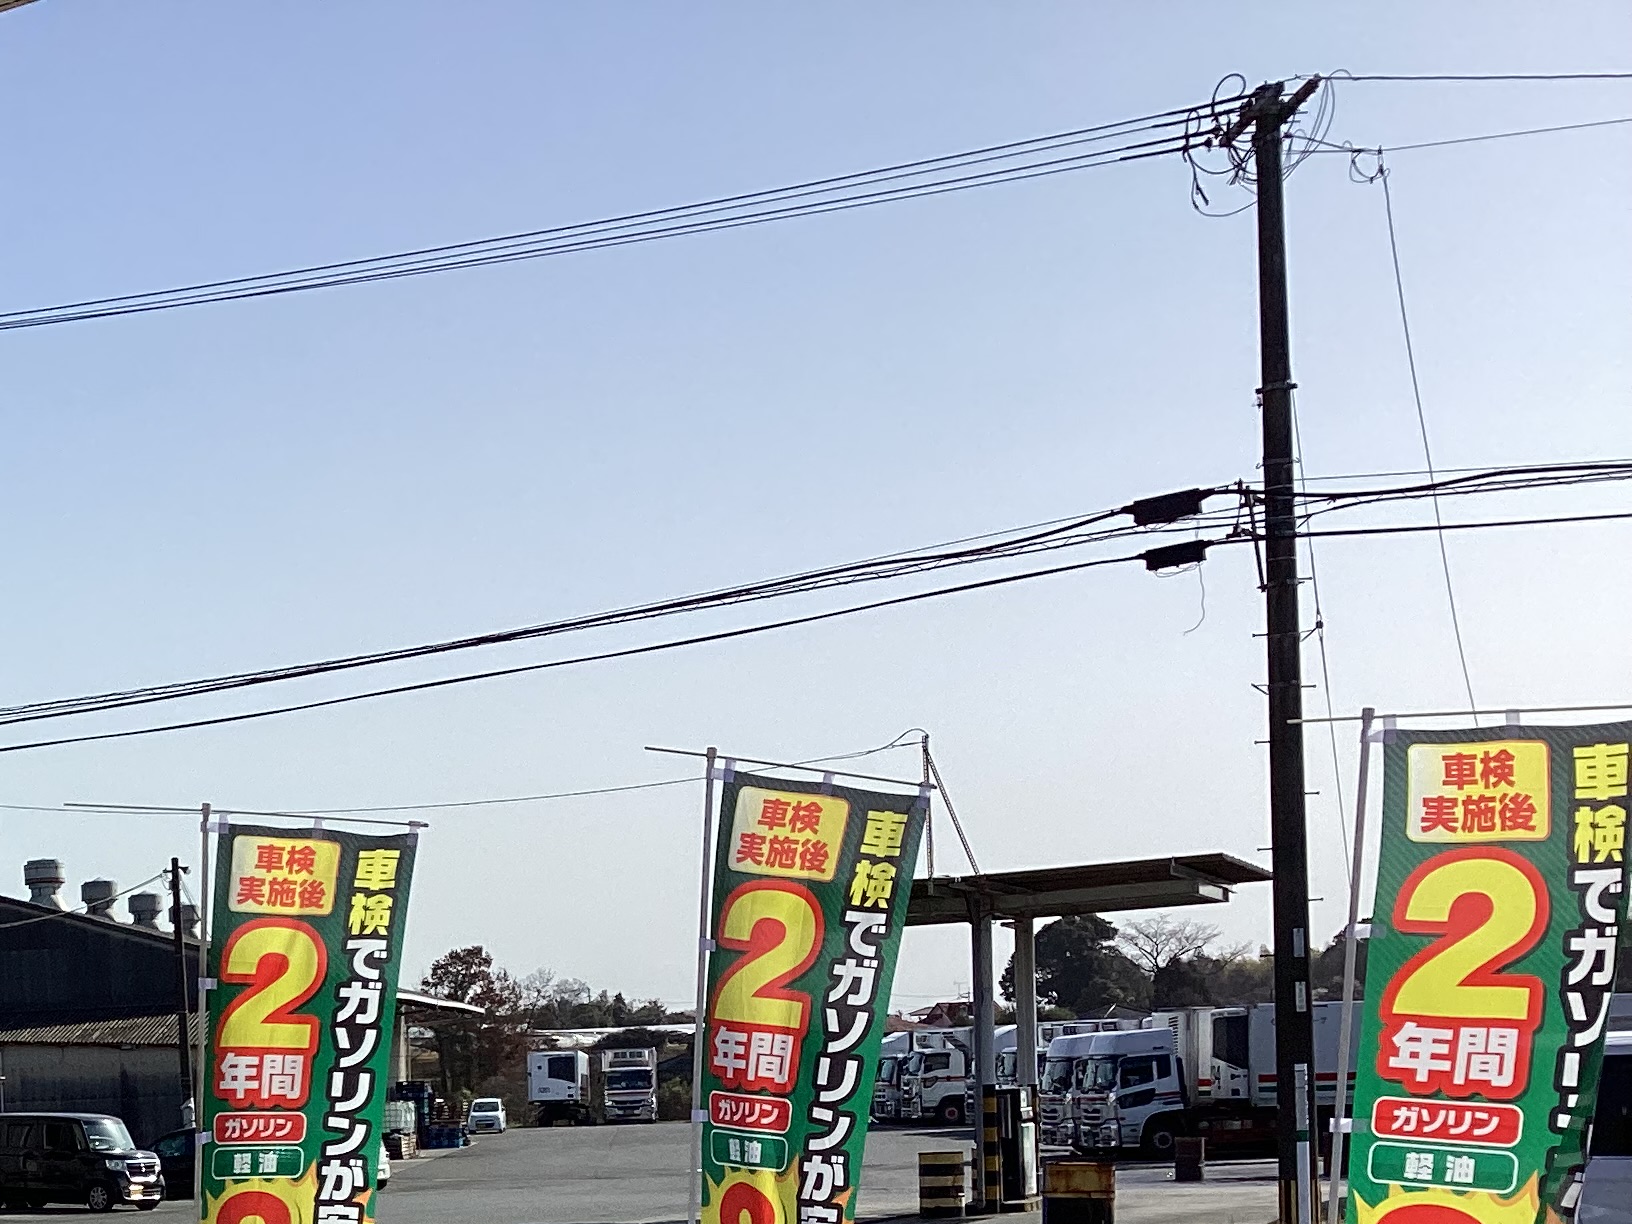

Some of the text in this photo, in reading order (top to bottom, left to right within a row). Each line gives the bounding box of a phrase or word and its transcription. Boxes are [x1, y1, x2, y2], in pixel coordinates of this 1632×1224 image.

[1442, 751, 1515, 790] 車検
[757, 799, 821, 834] 車検
[1420, 796, 1538, 834] 実施後
[255, 845, 315, 874] 車検
[735, 832, 829, 873] 実施後
[237, 876, 327, 908] 実施後
[1393, 860, 1531, 1019] 2
[716, 891, 815, 1029] 2
[220, 927, 319, 1049] 2
[711, 1031, 792, 1086] 年間
[1386, 1025, 1518, 1087] 年間
[220, 1053, 304, 1099] 年間
[225, 1117, 293, 1138] ガソリン
[718, 1098, 778, 1126] ガソリン
[1391, 1107, 1500, 1137] ガソリン
[1405, 1152, 1476, 1184] 軽油
